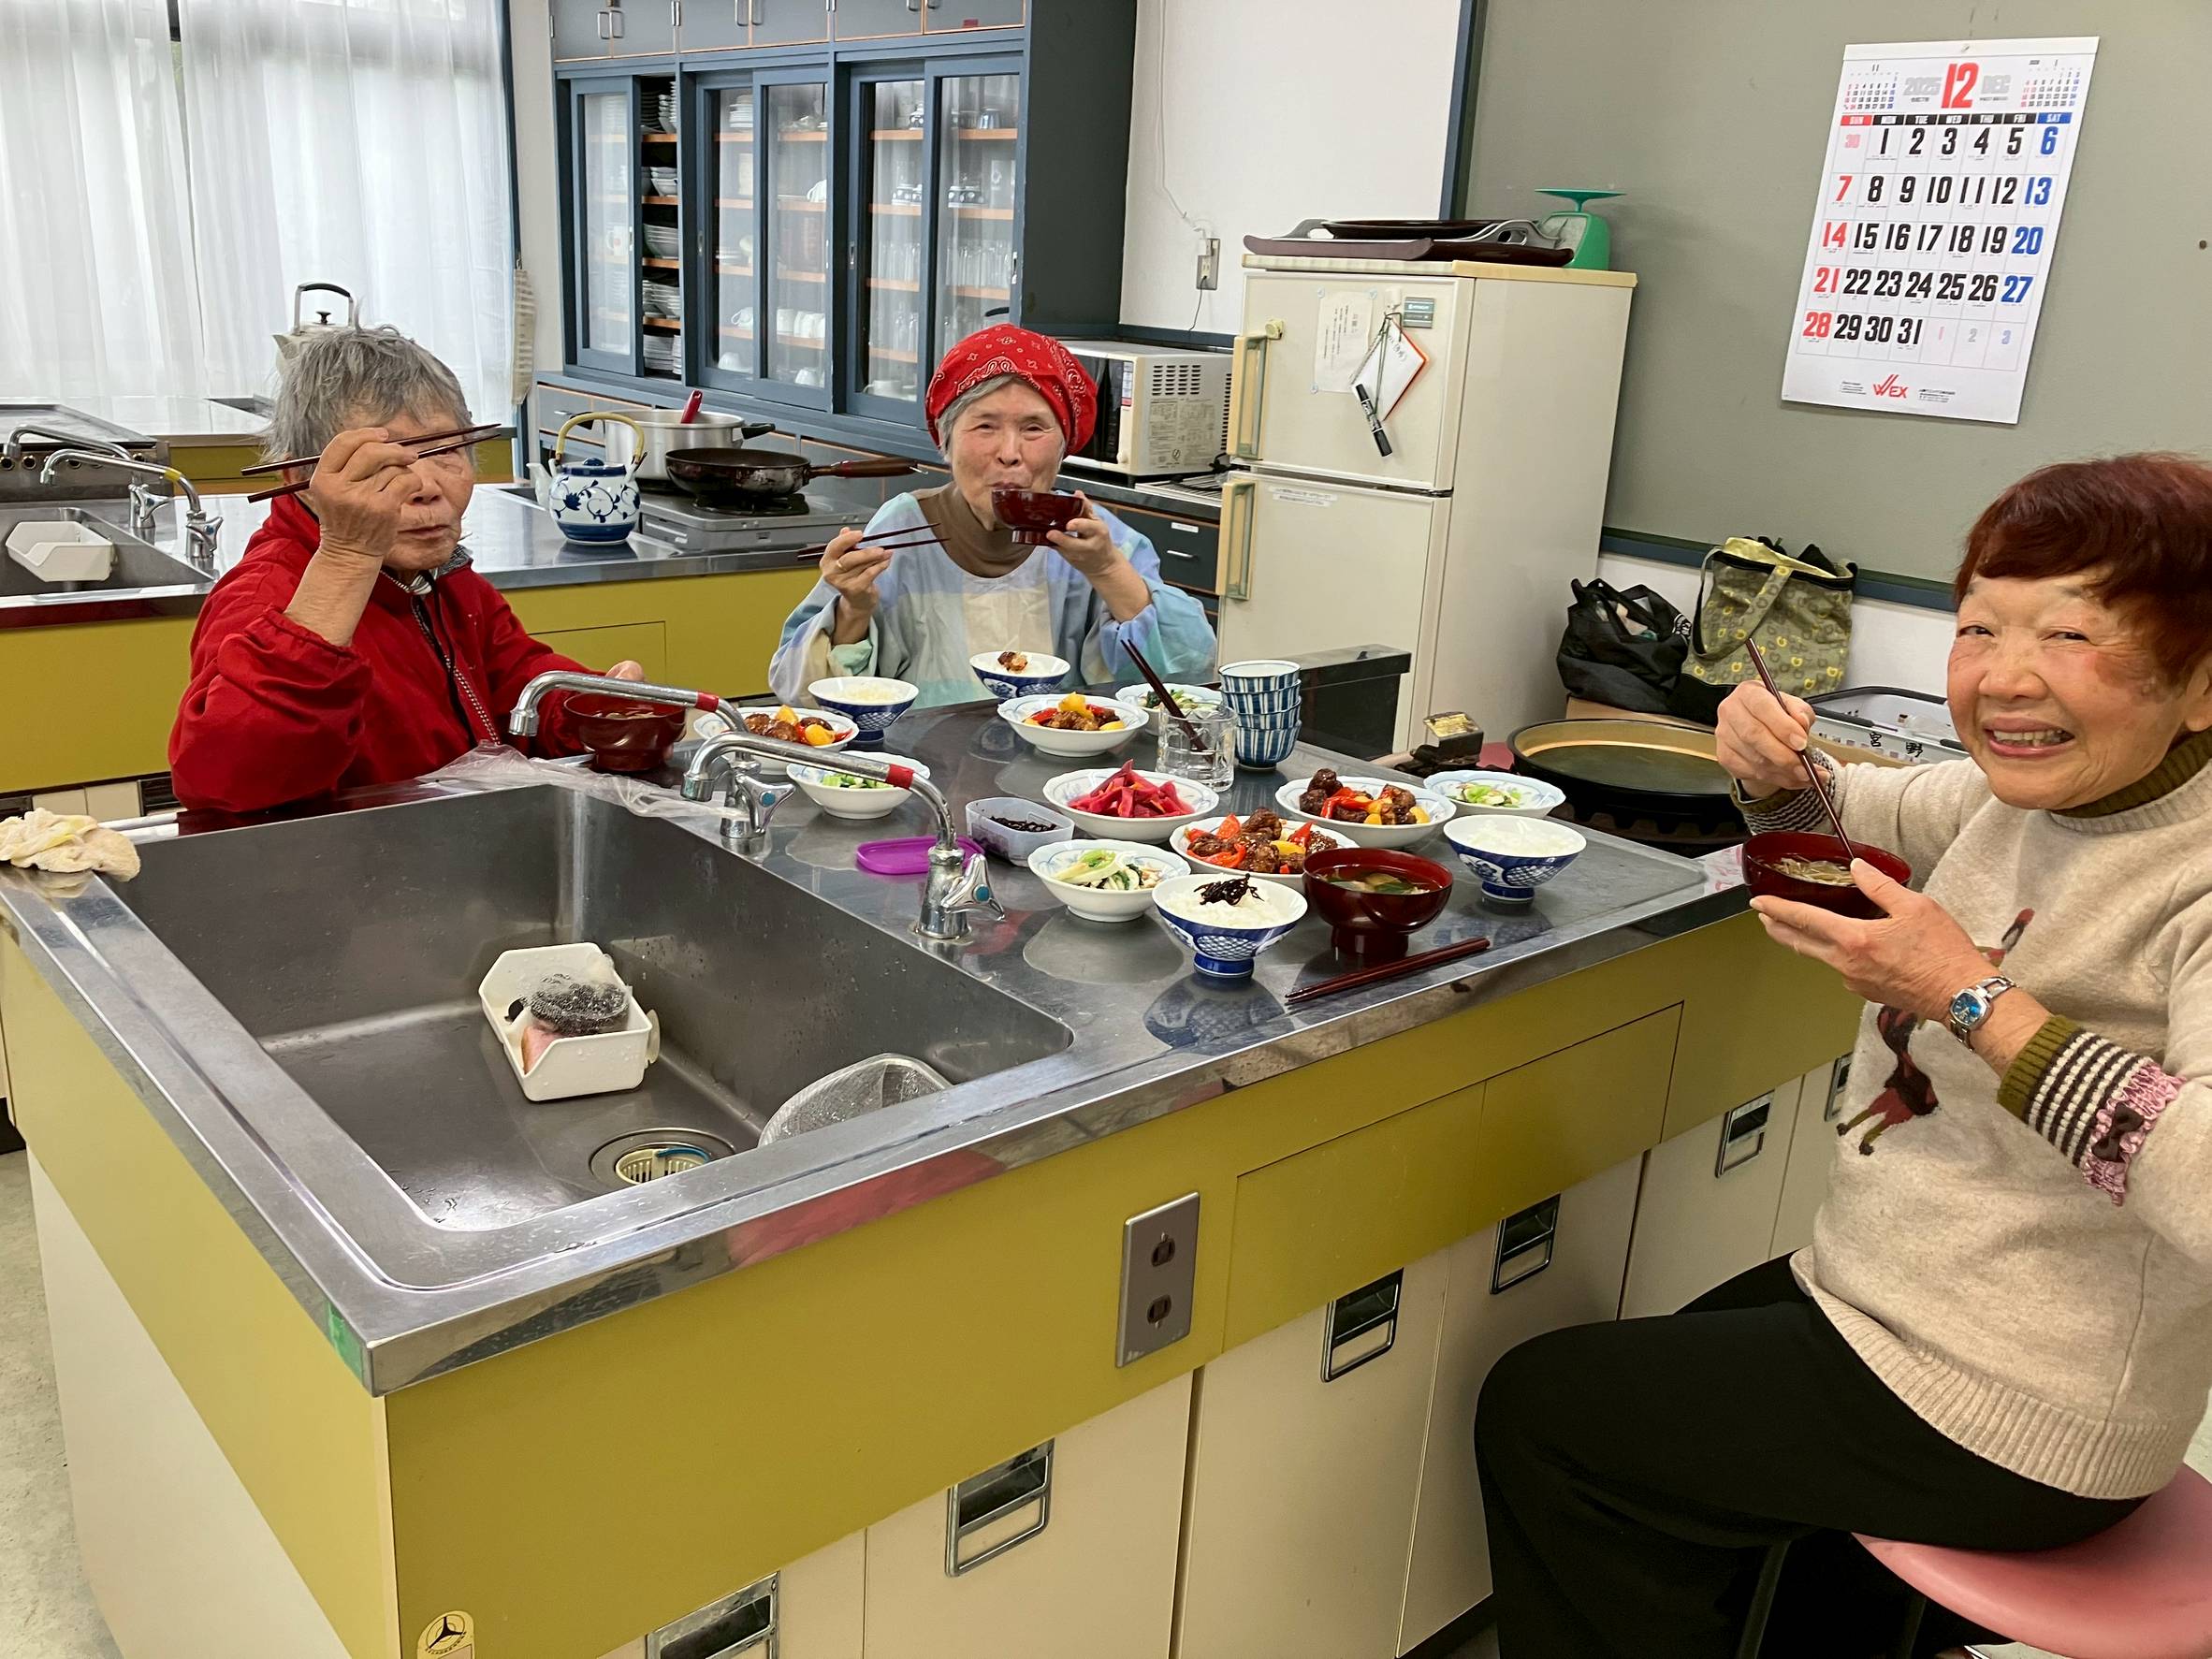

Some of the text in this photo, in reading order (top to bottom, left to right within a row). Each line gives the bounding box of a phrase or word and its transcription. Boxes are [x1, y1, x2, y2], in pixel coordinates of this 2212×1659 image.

[1903, 63, 2011, 109] 2025 12 DEC
[1914, 116, 1928, 124] TUE
[1945, 116, 1962, 124] WED
[1980, 115, 1995, 124] THU
[2014, 114, 2027, 123] FRI
[2046, 114, 2061, 123] SAT
[1880, 128, 1889, 154] 1
[1909, 127, 1926, 154] 2
[1942, 127, 1957, 154] 3
[1974, 127, 1990, 154] 4
[2007, 127, 2025, 154] 5
[2040, 126, 2059, 155] 6
[1836, 175, 2053, 206] 7 8 9 10 11 12 13
[1823, 222, 2044, 255] 14 15 16 17 18 19 20
[1813, 267, 2034, 303] 21 22 23 24 25 26 27
[1802, 312, 2012, 345] 28 29 30 31 1 2 3
[1872, 373, 1909, 399] WEX
